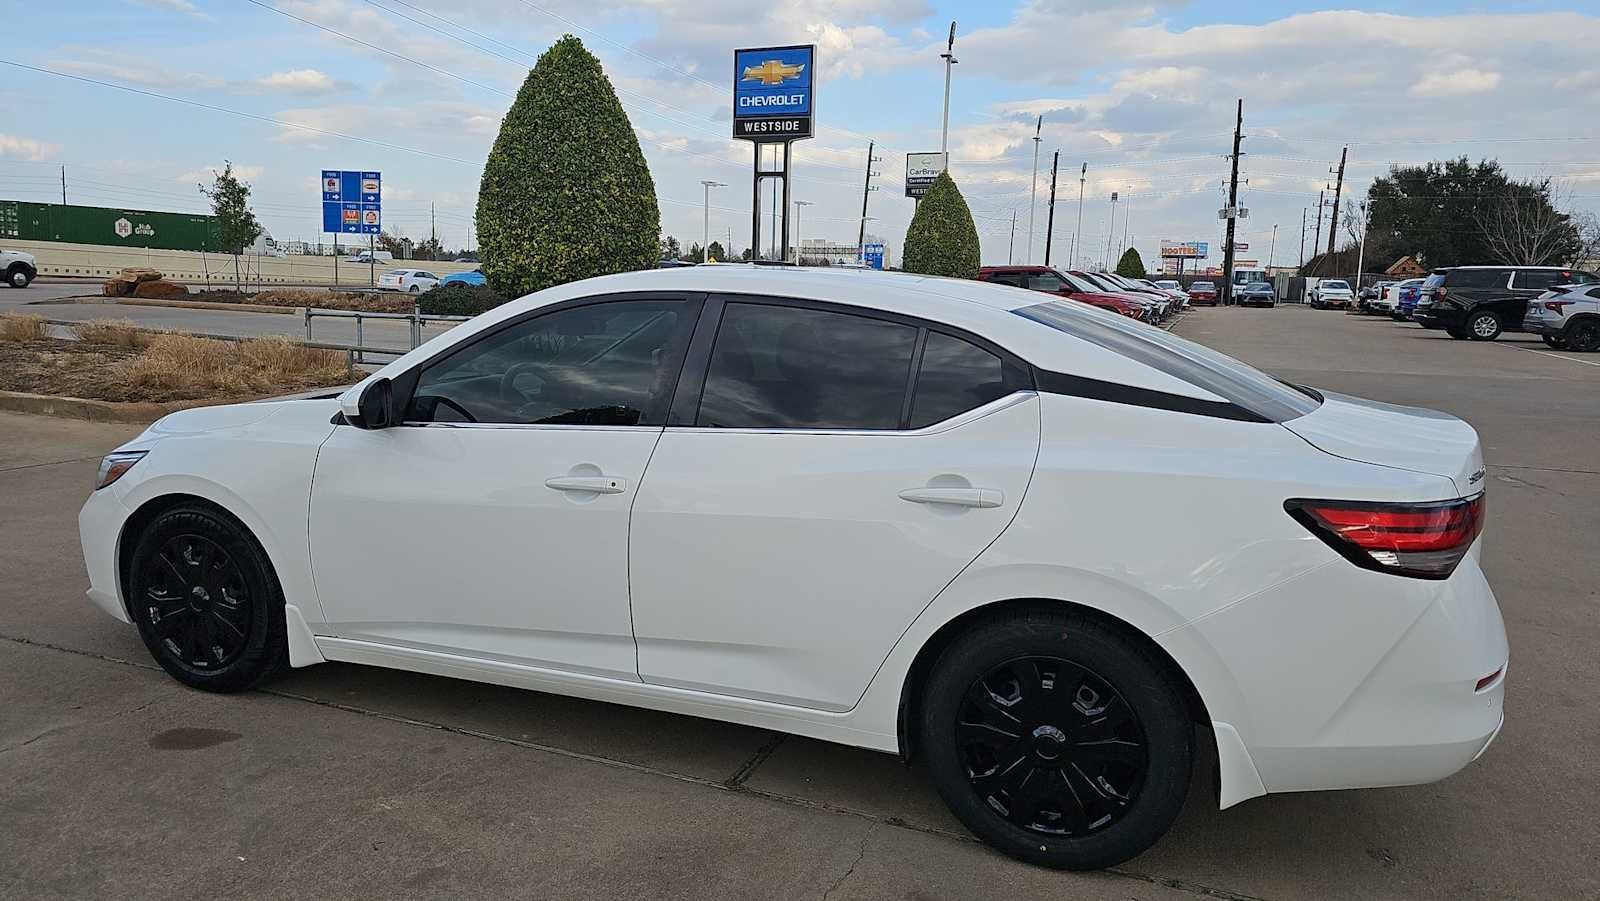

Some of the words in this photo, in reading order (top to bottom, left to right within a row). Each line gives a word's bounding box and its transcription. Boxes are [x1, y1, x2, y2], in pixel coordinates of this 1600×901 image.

[739, 94, 805, 107] CHEVROLET
[744, 121, 800, 132] WESTSIDE
[1161, 247, 1197, 255] HOOTERS
